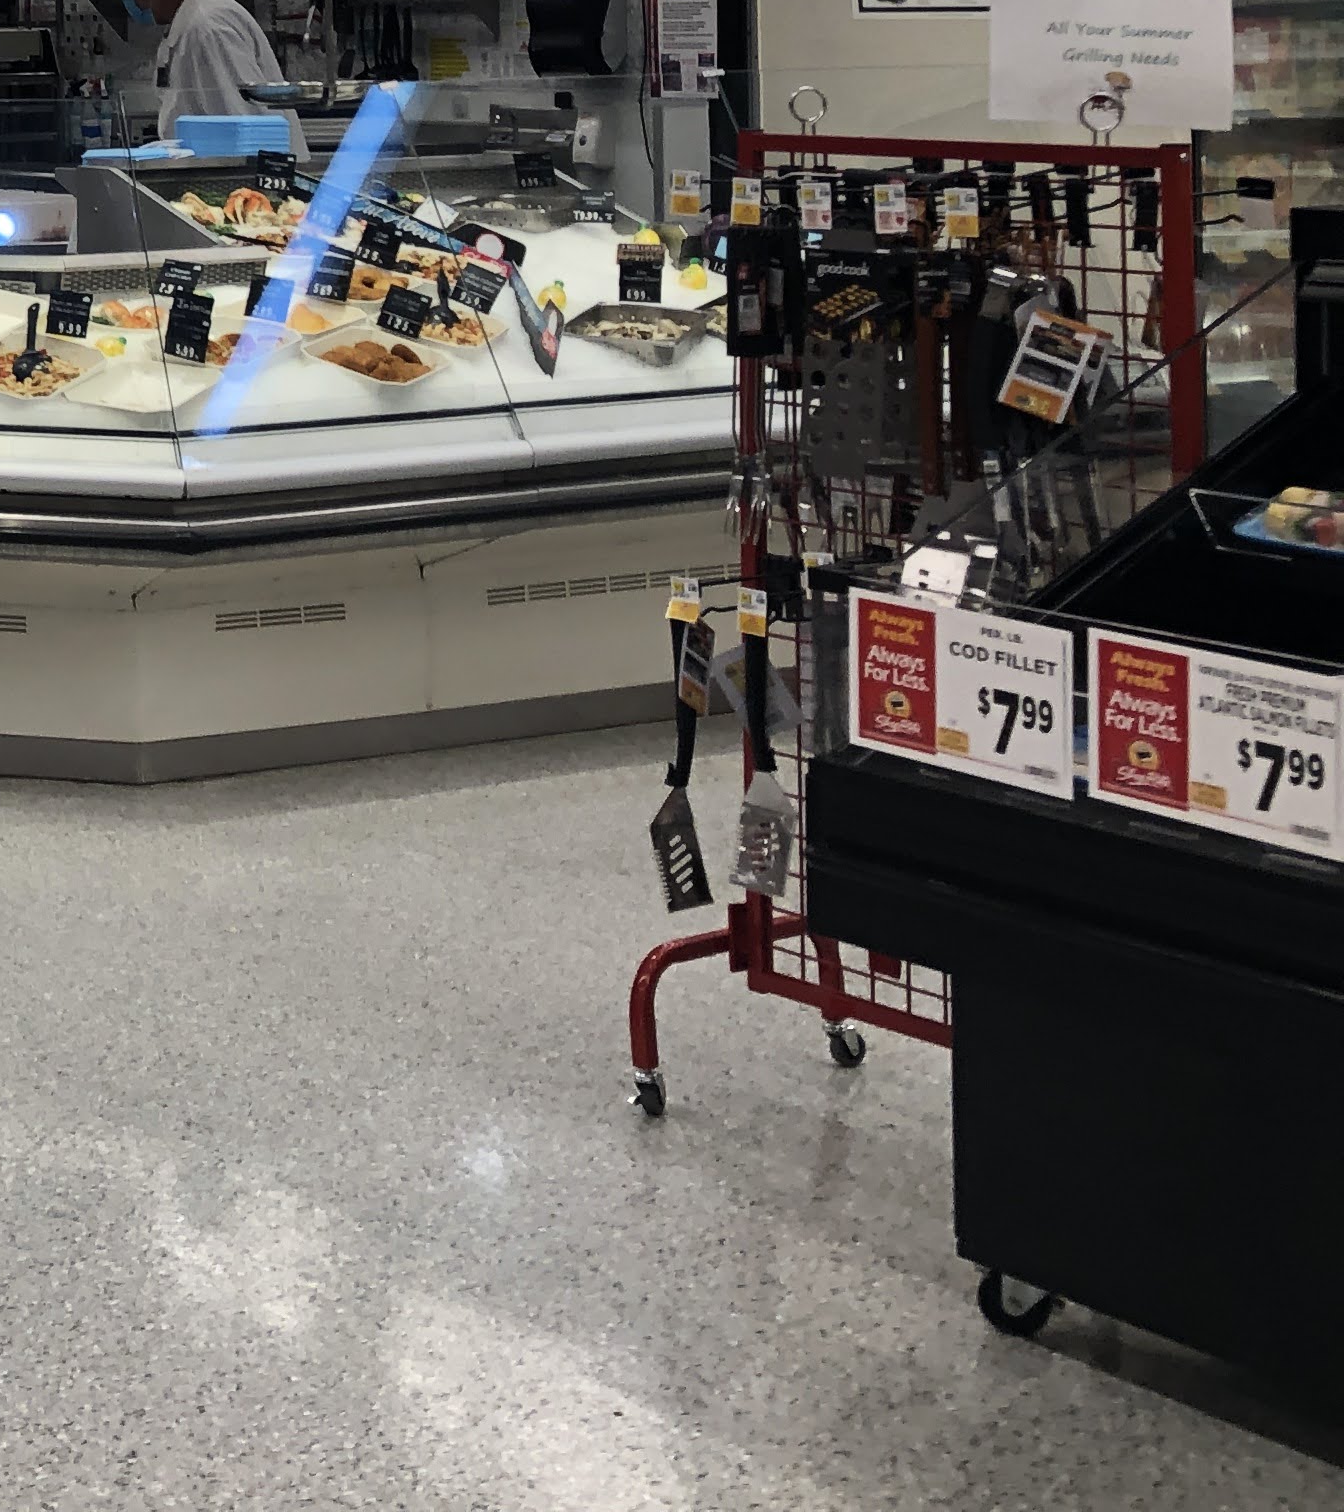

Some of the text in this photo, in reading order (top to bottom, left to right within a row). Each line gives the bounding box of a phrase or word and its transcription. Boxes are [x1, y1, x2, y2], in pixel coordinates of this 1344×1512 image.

[1046, 20, 1193, 39] All Your Summer
[1062, 48, 1179, 67] Grilling Needs
[869, 609, 924, 631] Always
[869, 645, 926, 673] Always
[949, 641, 1058, 676] COD FILLET
[1110, 651, 1176, 679] Always
[865, 662, 890, 681] For
[1110, 690, 1177, 723] Always
[1105, 709, 1135, 731] For
